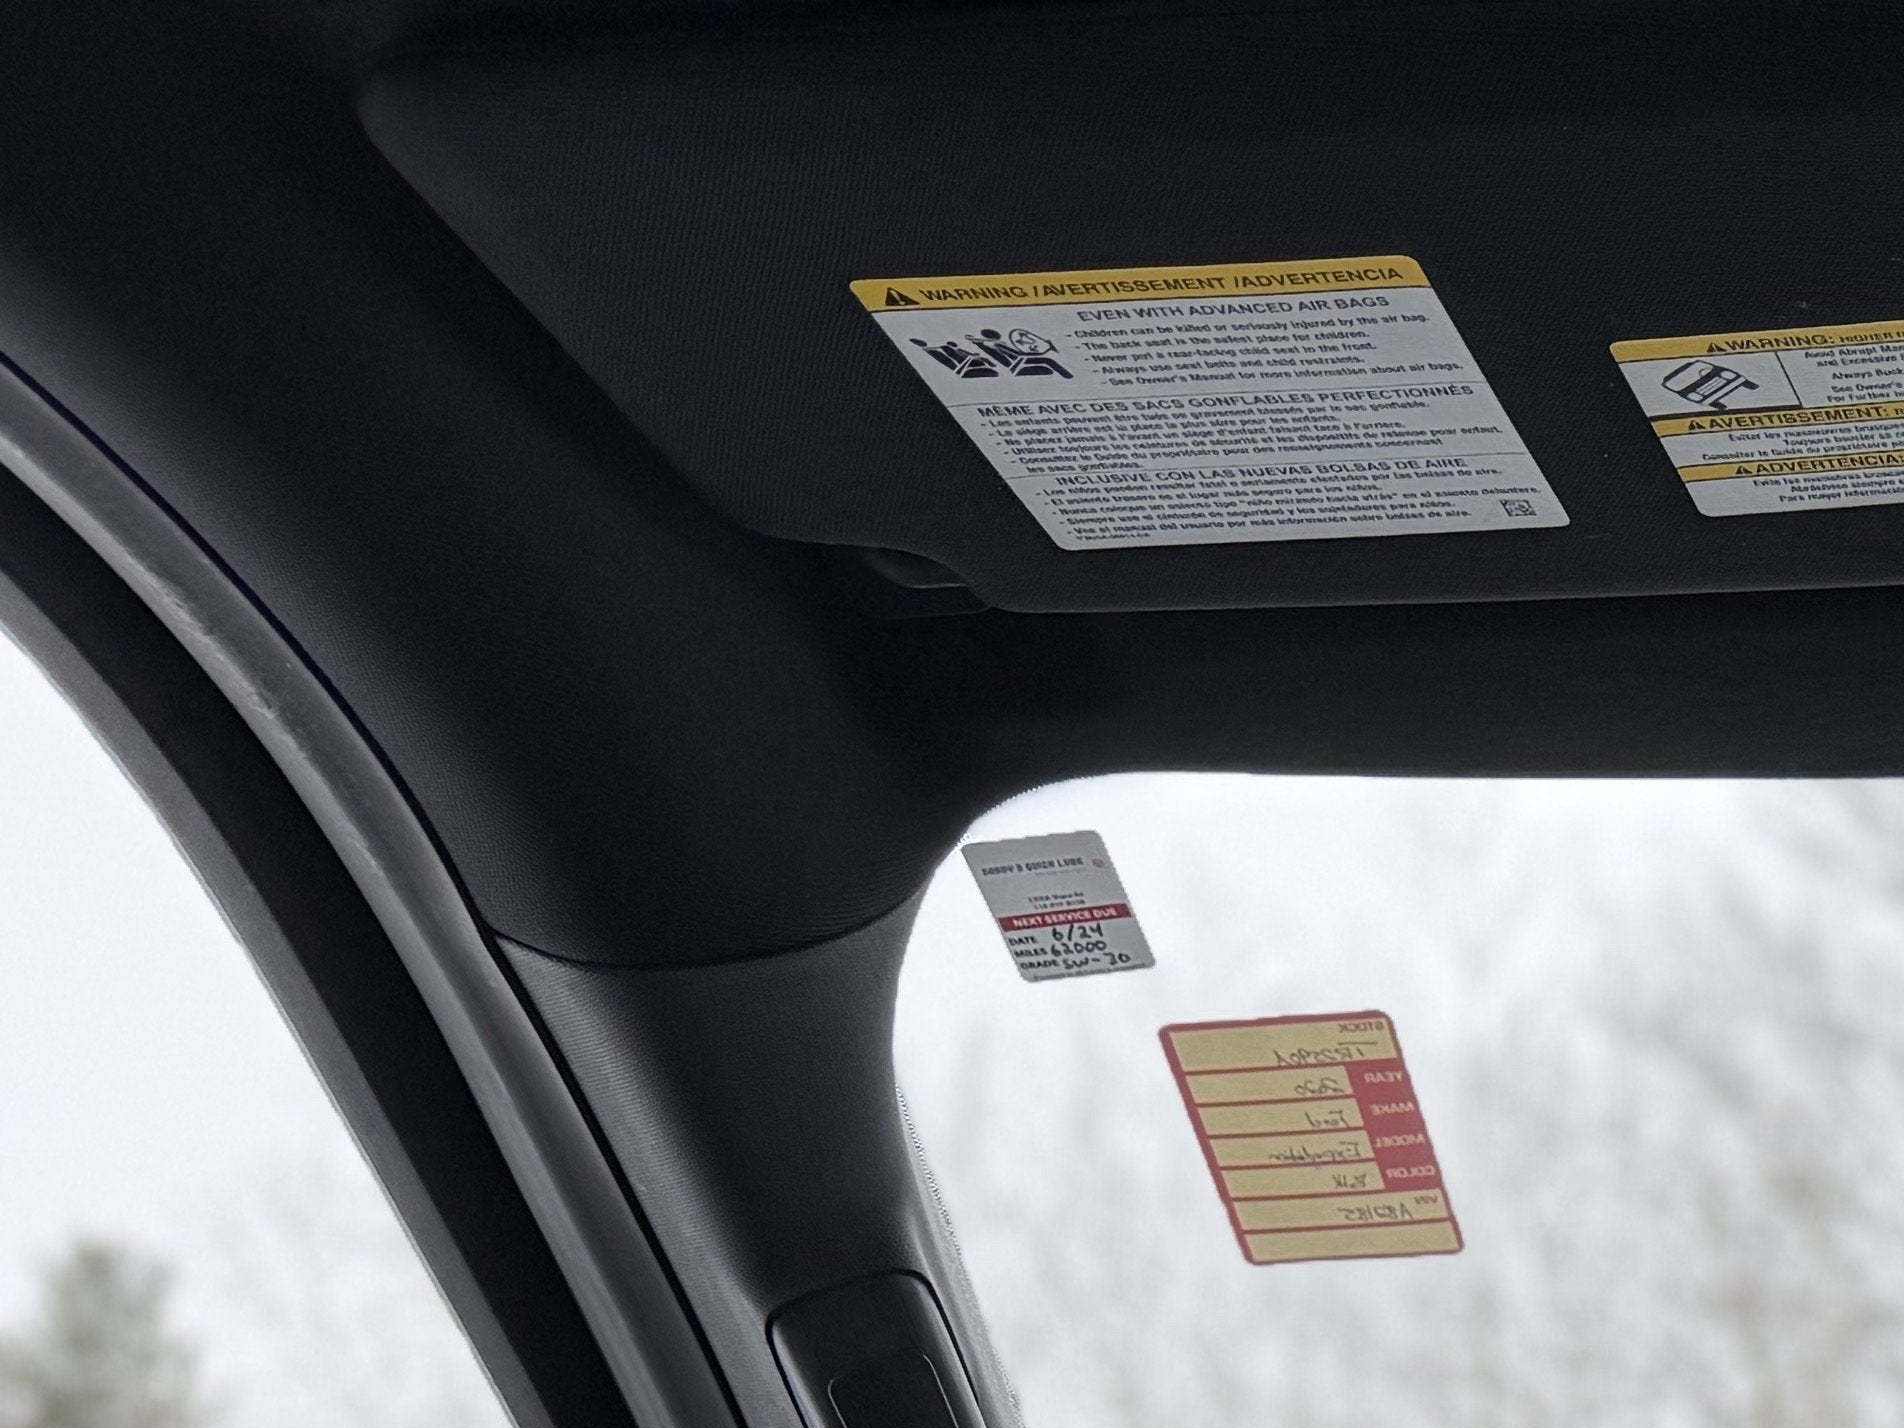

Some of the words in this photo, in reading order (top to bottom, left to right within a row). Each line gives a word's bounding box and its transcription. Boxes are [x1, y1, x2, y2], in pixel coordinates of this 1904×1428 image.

[918, 286, 1029, 301] WARNING
[1076, 309, 1131, 322] EVEN
[1132, 305, 1185, 319] WITH
[1189, 302, 1293, 316] ADVANCED
[1298, 300, 1331, 312] AIR
[1335, 296, 1390, 310] BAGS
[1074, 328, 1128, 339] Children
[1130, 328, 1155, 337] can
[1156, 325, 1173, 335] be
[1175, 324, 1212, 333] killed
[1231, 319, 1287, 332] seriously
[1291, 318, 1336, 331] injured
[1338, 318, 1354, 329] by
[1356, 316, 1379, 325] the
[1381, 315, 1398, 324] air
[1401, 313, 1430, 325] bag.
[1725, 334, 1836, 350] WARNING:
[977, 403, 1034, 418] MÊME
[1038, 402, 1087, 414] AVEC
[1089, 400, 1129, 413] DES
[1131, 398, 1185, 411] SACS
[1188, 392, 1315, 408] GONFLABLES
[1317, 384, 1474, 403] PERFECTIONNÉS
[1708, 406, 1889, 430] AVERTISSEMENT:
[1055, 472, 1151, 486] INCLUSIVE
[1154, 470, 1195, 482] CON
[1198, 467, 1233, 480] LAS
[1238, 464, 1314, 478] NUEVAS
[1315, 460, 1391, 475] BOLSAS
[1394, 459, 1421, 470] DE
[1425, 457, 1469, 468] AIRE
[1045, 909, 1092, 925] SERVICE
[1093, 906, 1118, 917] DUE
[1008, 936, 1038, 946] DATE
[1052, 923, 1104, 942] 6/24
[1014, 947, 1048, 958] MILES
[1051, 940, 1107, 957] 62000
[1020, 958, 1060, 970] GRADE
